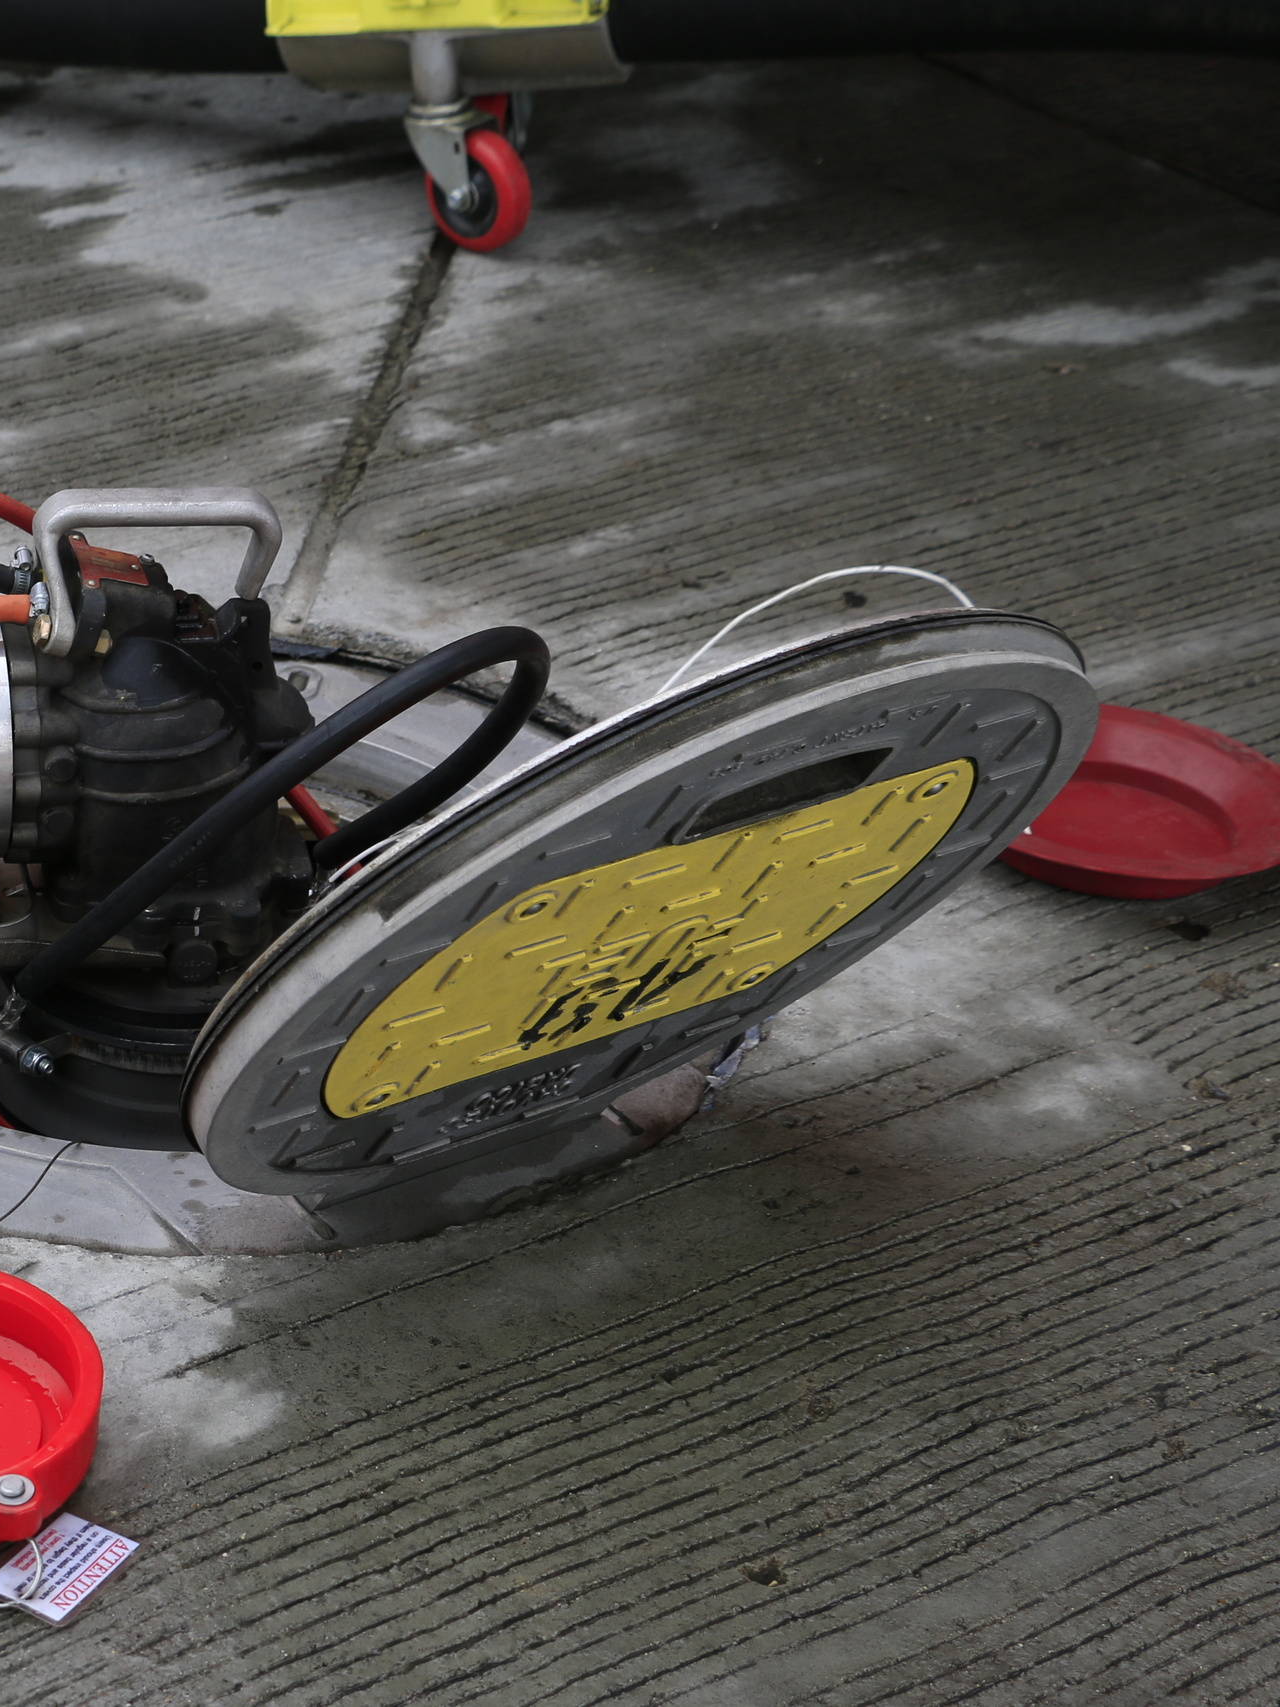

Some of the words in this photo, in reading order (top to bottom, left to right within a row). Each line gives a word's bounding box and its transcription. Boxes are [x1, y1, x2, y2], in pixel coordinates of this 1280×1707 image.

[63, 1535, 79, 1547] they
[94, 1534, 112, 1548] Users
[49, 1545, 68, 1559] begin
[67, 1540, 89, 1558] regular
[79, 1547, 98, 1563] should
[55, 1556, 73, 1569] basis
[46, 1568, 60, 1578] and
[53, 1540, 130, 1611] ATTENTION
[61, 1561, 83, 1579] inspect
[54, 1577, 66, 1586] the
[38, 1584, 58, 1600] covers
